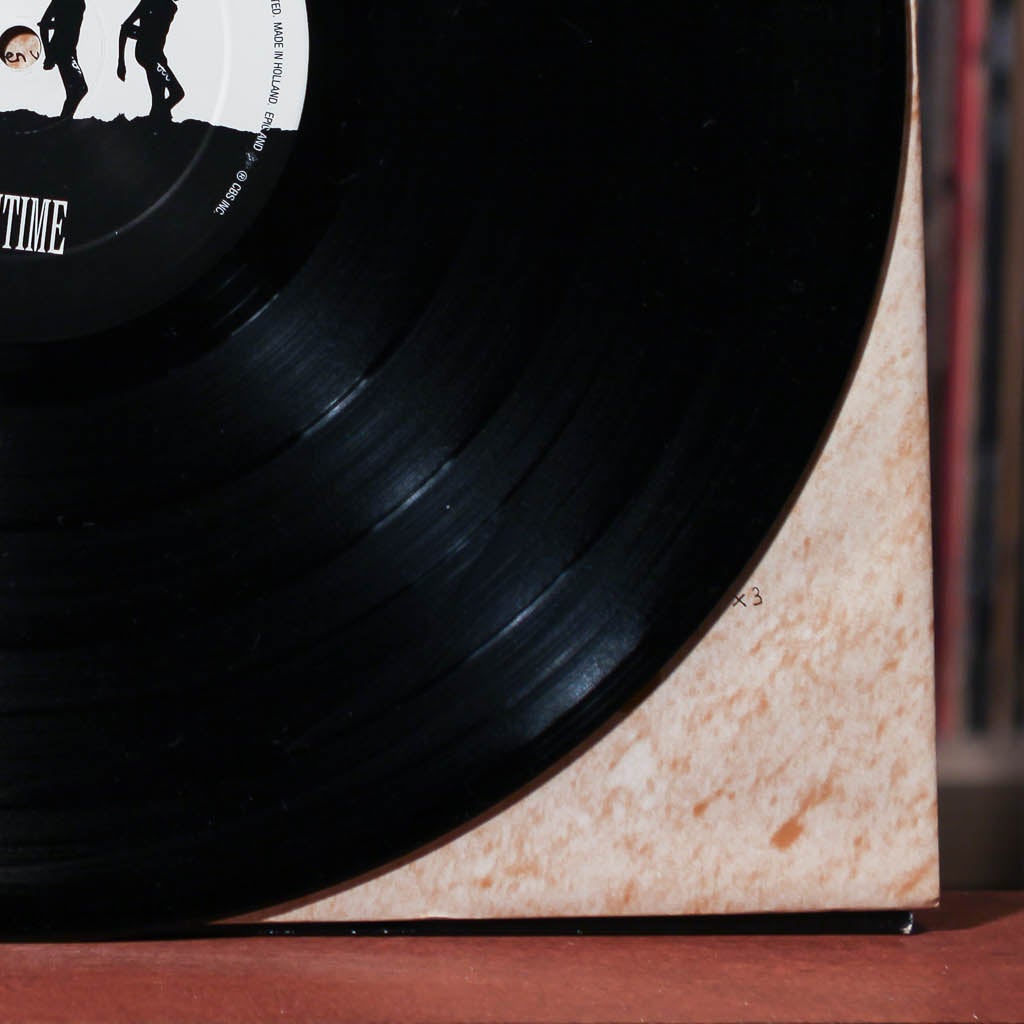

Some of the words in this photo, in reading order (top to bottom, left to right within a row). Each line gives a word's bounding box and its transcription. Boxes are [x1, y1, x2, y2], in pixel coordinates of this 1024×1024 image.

[273, 22, 284, 49] MADE
[273, 50, 284, 60] IN
[252, 130, 268, 152] AND
[225, 182, 242, 201] CBS
